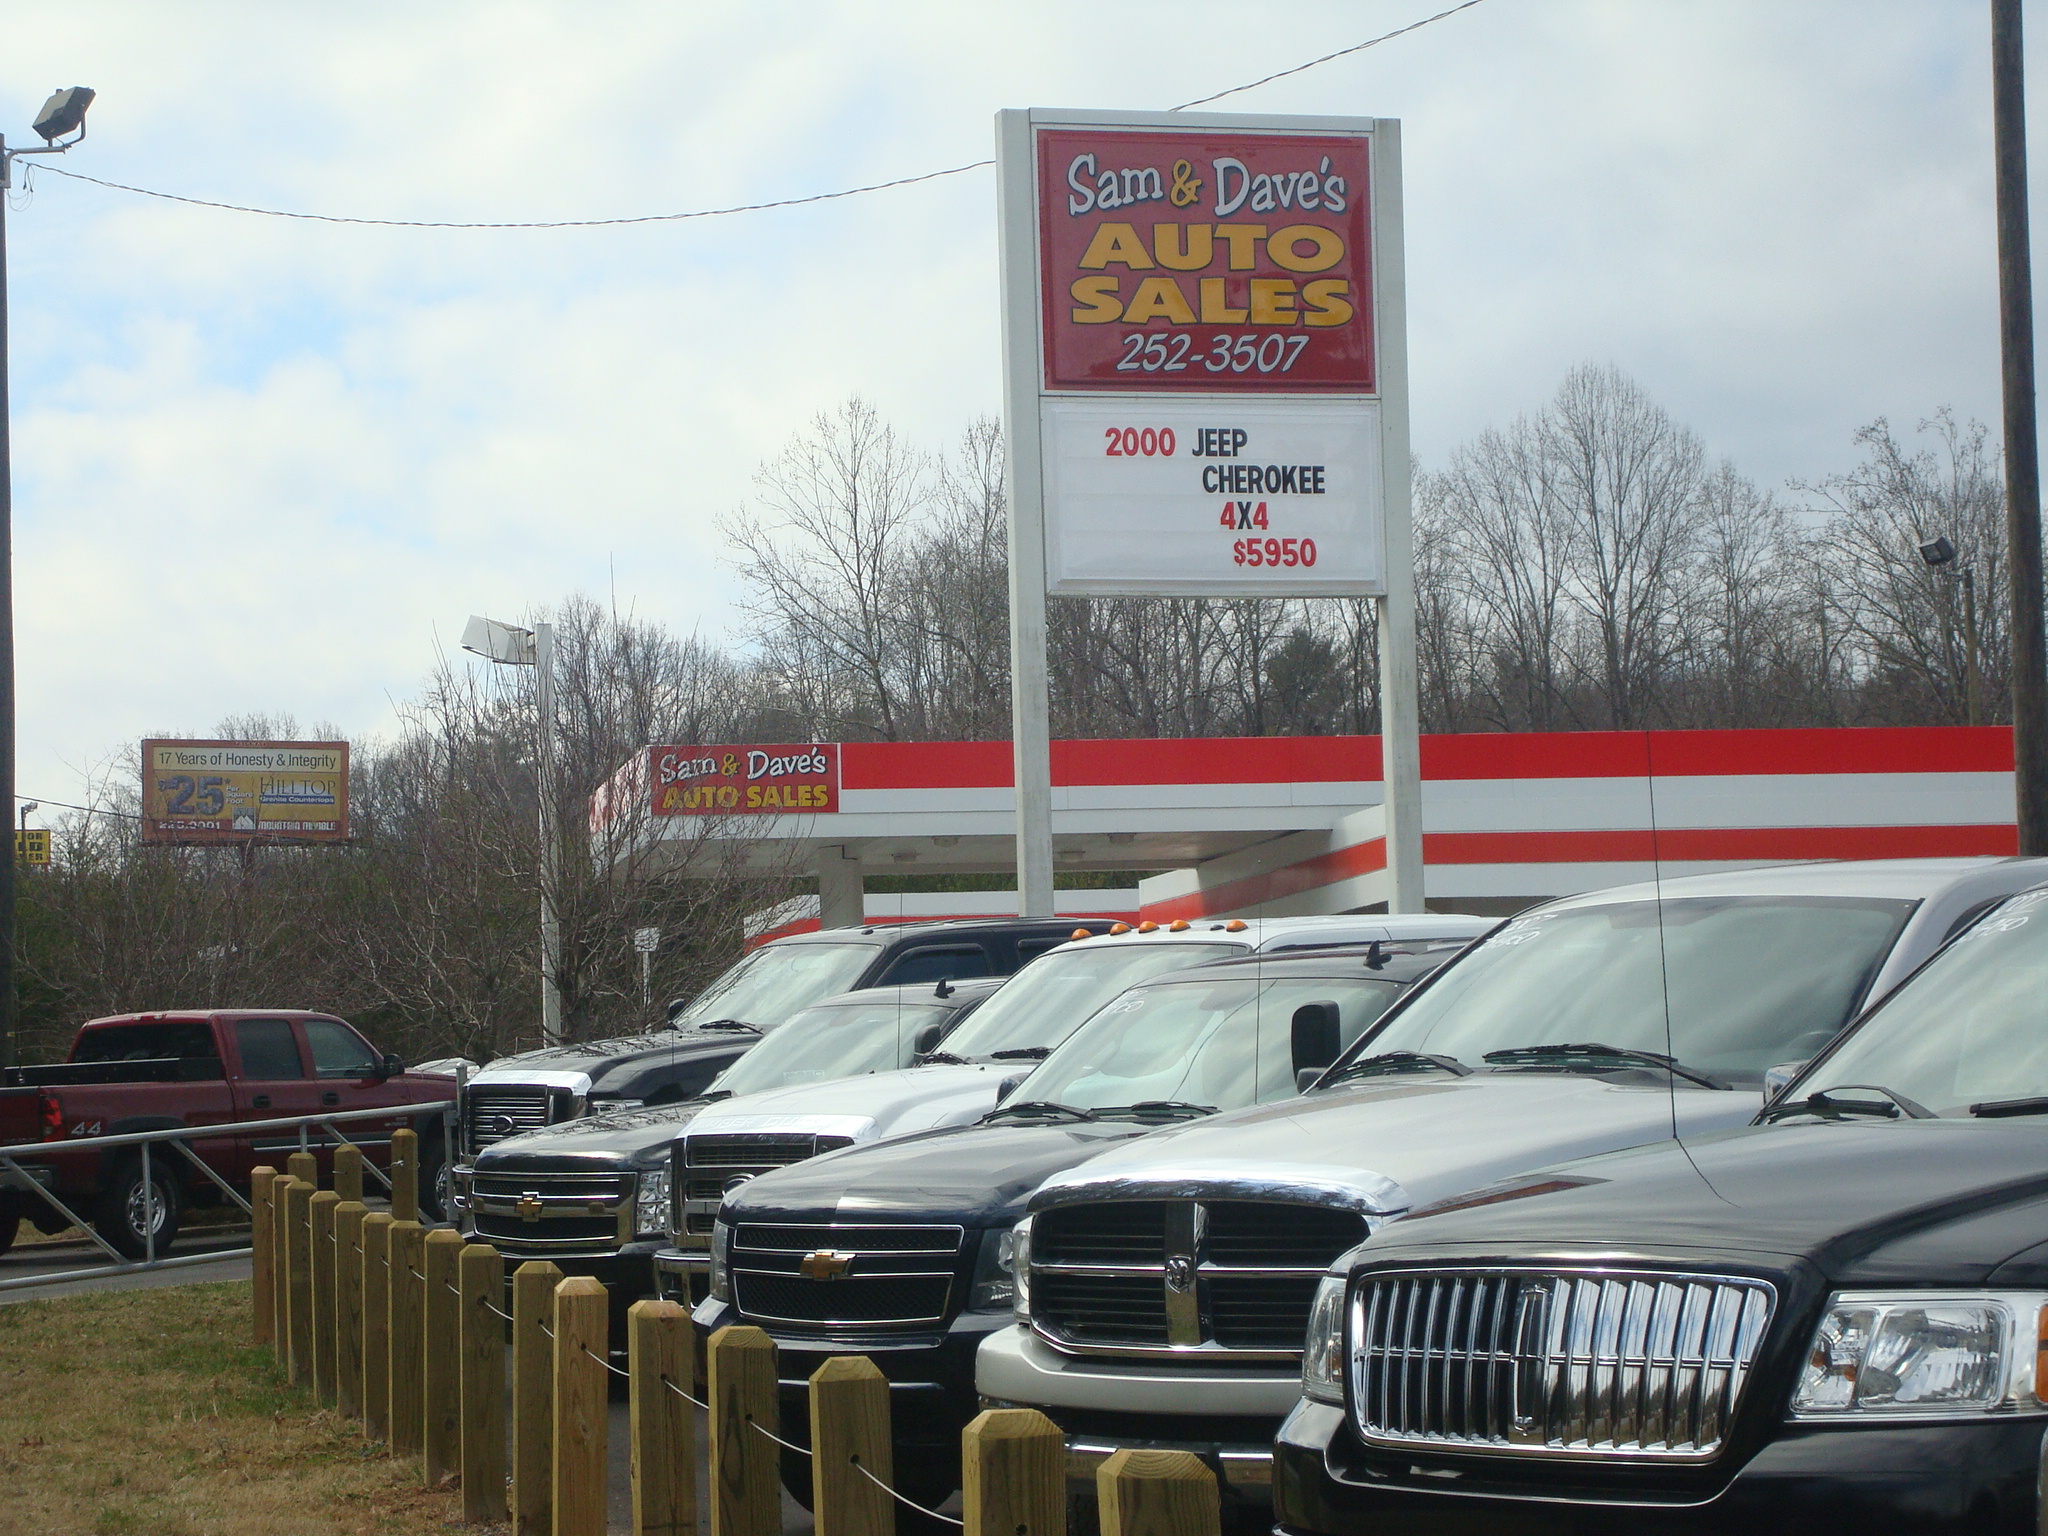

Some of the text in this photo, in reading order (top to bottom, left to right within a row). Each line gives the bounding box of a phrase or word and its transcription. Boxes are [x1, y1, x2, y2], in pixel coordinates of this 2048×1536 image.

[1068, 153, 1347, 217] Sam & Dave's
[1078, 222, 1345, 273] AUTO
[1070, 275, 1354, 328] SALES
[1116, 333, 1310, 373] 252-3507
[1105, 427, 1248, 457] 2000 JEEP
[1202, 465, 1326, 494] CHEROKEE
[1220, 501, 1269, 530] 4X4
[1233, 538, 1317, 567] $5950
[159, 752, 336, 769] 17 Years of Honesty & Integrity
[660, 746, 828, 784] Sam & Dave's
[260, 775, 336, 796] HILLTOP
[288, 796, 335, 804] Countertops
[662, 784, 829, 809] AUTO SALES
